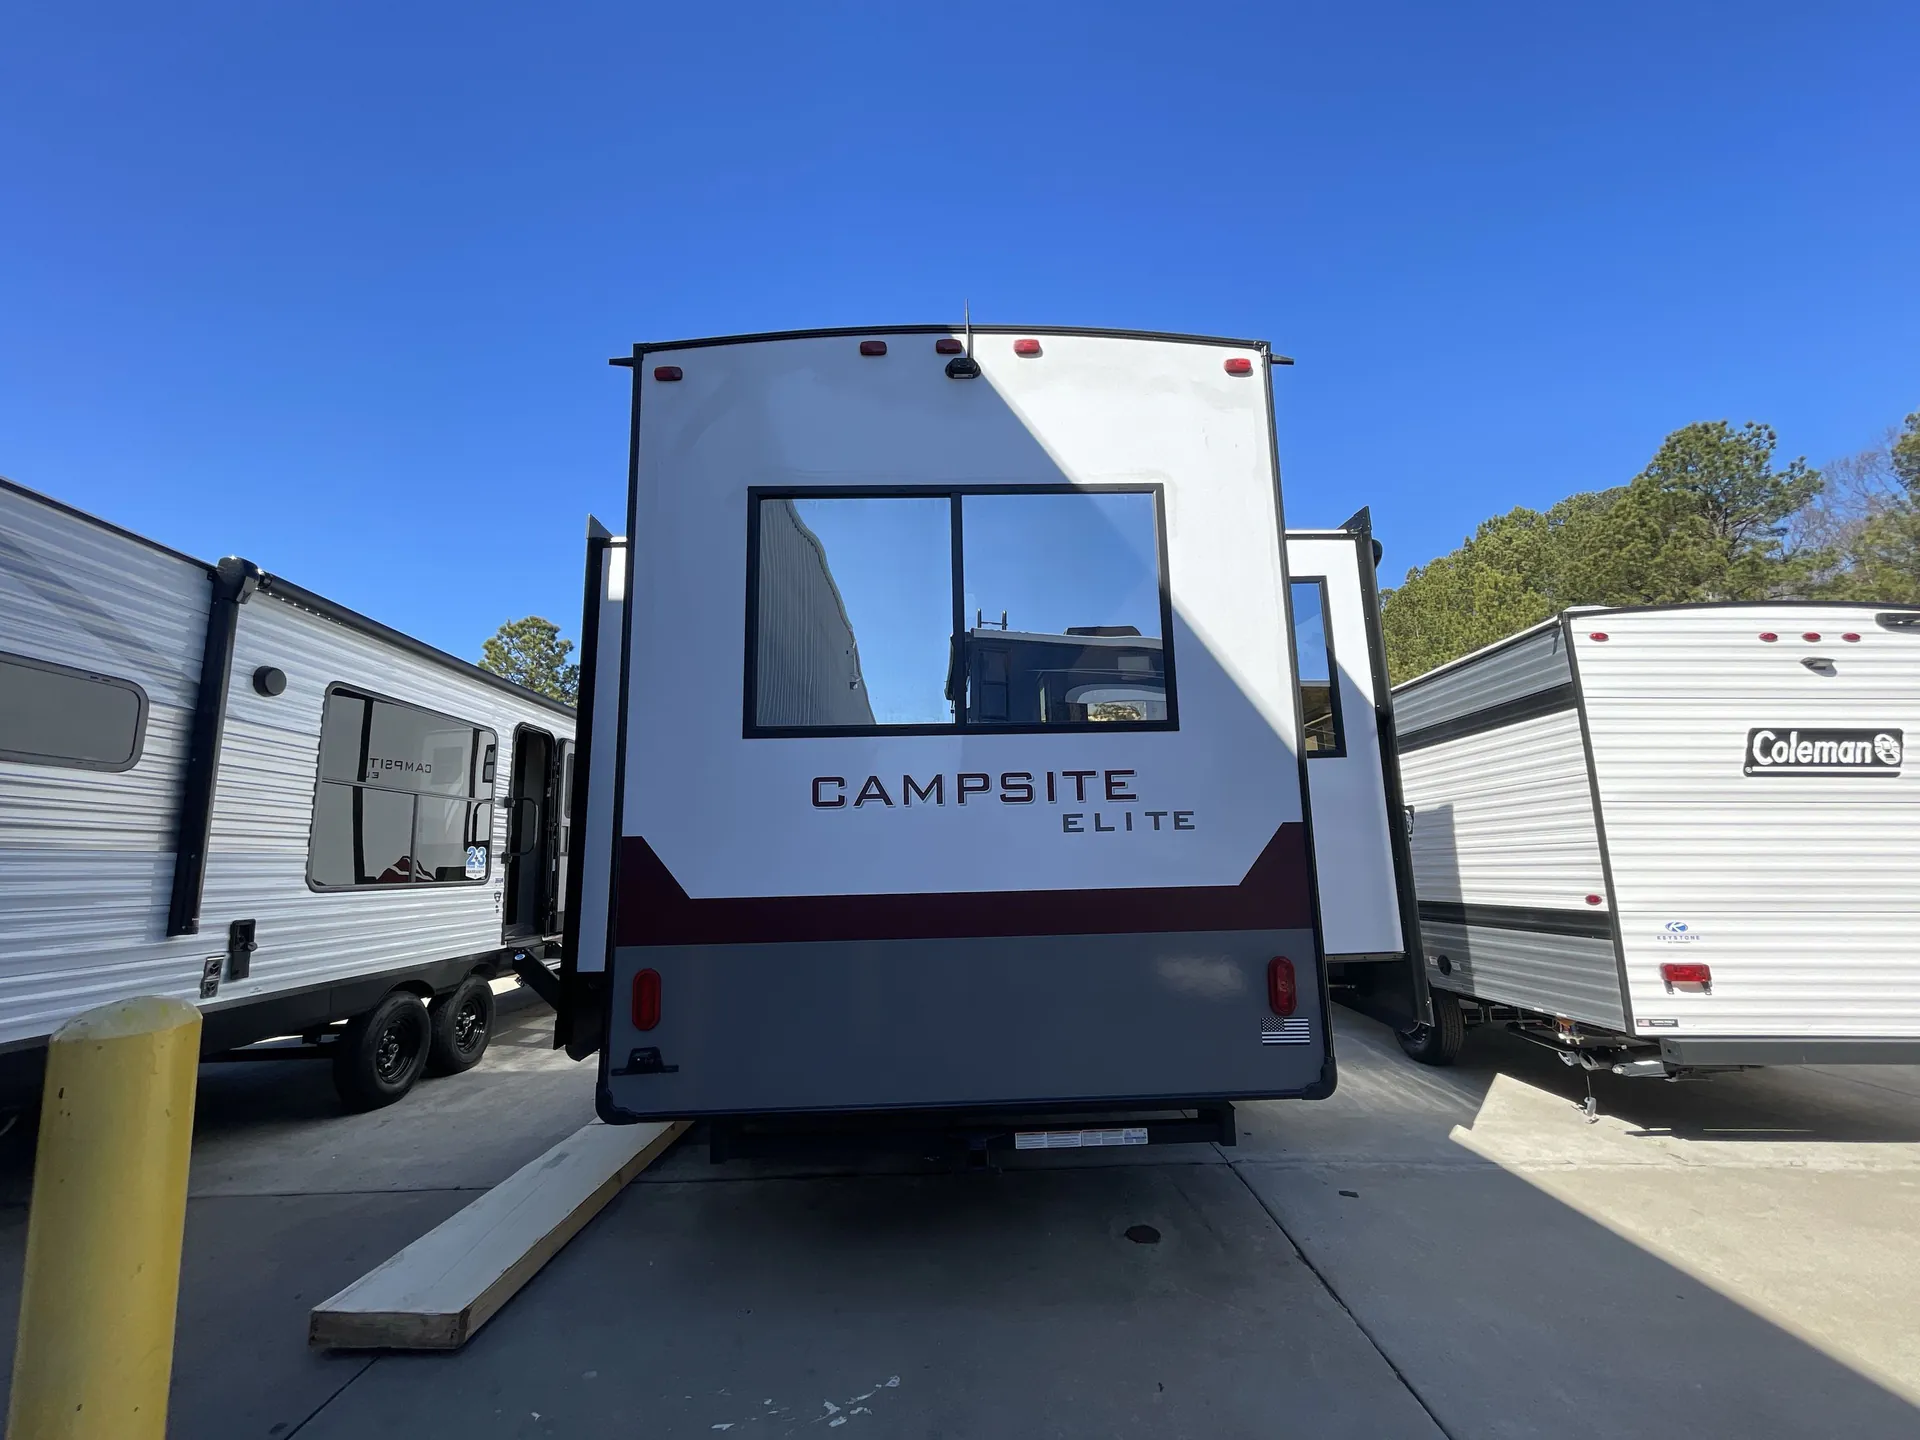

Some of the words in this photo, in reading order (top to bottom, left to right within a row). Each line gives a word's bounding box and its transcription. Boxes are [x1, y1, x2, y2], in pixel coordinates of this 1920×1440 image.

[1752, 730, 1873, 766] Coleman
[811, 768, 1139, 809] CAMPSITE
[1062, 809, 1196, 834] ELITE
